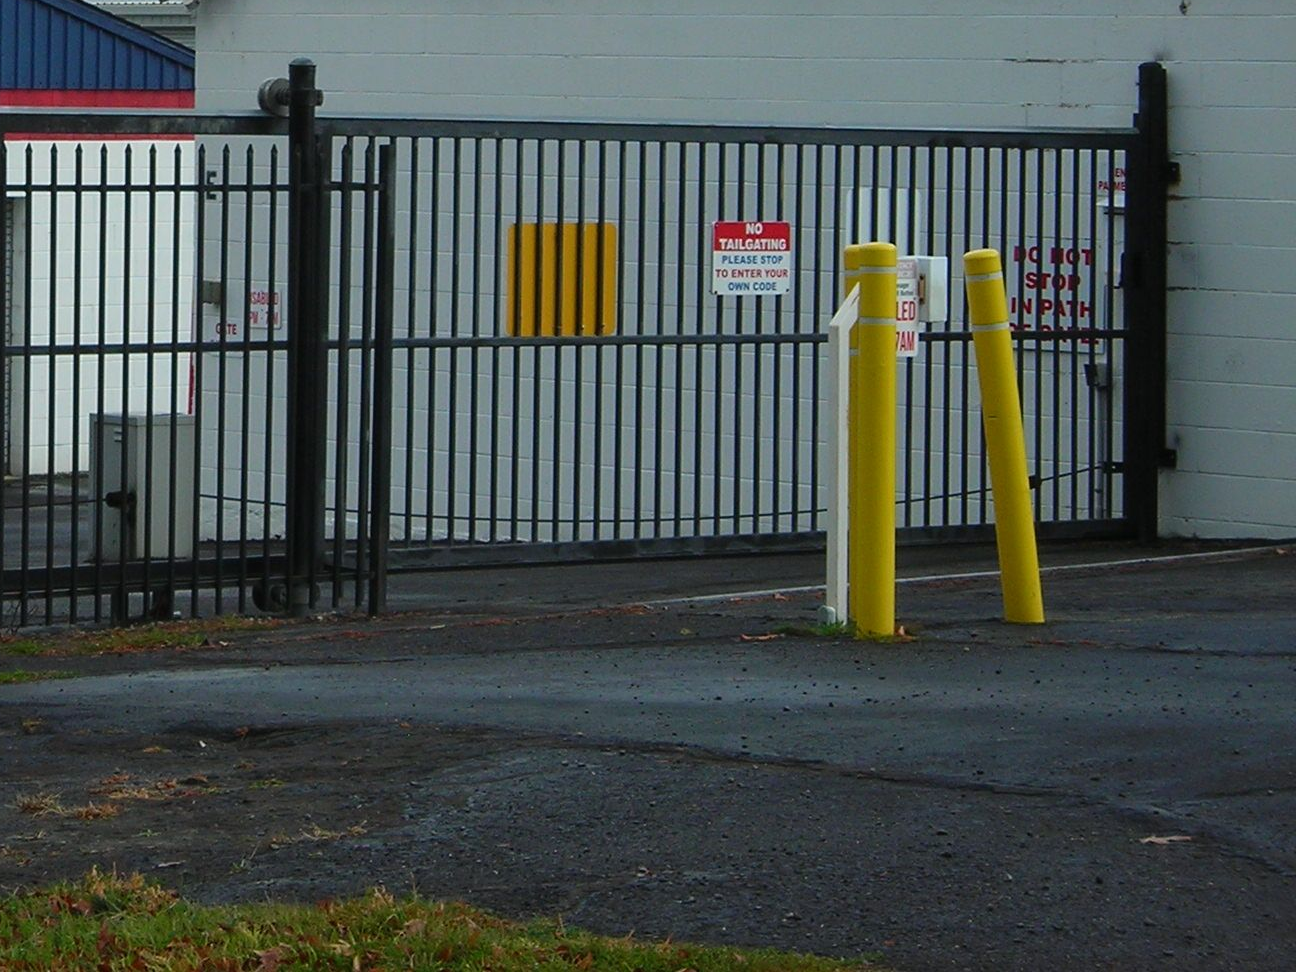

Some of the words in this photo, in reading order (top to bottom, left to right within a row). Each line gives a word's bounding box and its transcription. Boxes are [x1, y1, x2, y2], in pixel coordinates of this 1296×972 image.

[745, 222, 763, 235] NO
[718, 238, 787, 250] TAILGATING
[721, 255, 758, 265] PLEASE
[760, 255, 783, 265] STOP
[1013, 245, 1039, 263] DO
[1050, 247, 1093, 265] NOT
[715, 269, 729, 278] TO
[731, 269, 762, 278] ENTER
[764, 269, 788, 278] YOUR
[727, 282, 750, 291] OWN
[752, 282, 777, 291] CODE
[1025, 271, 1081, 291] STOP
[1010, 296, 1033, 315] IN
[1039, 298, 1093, 318] PATH
